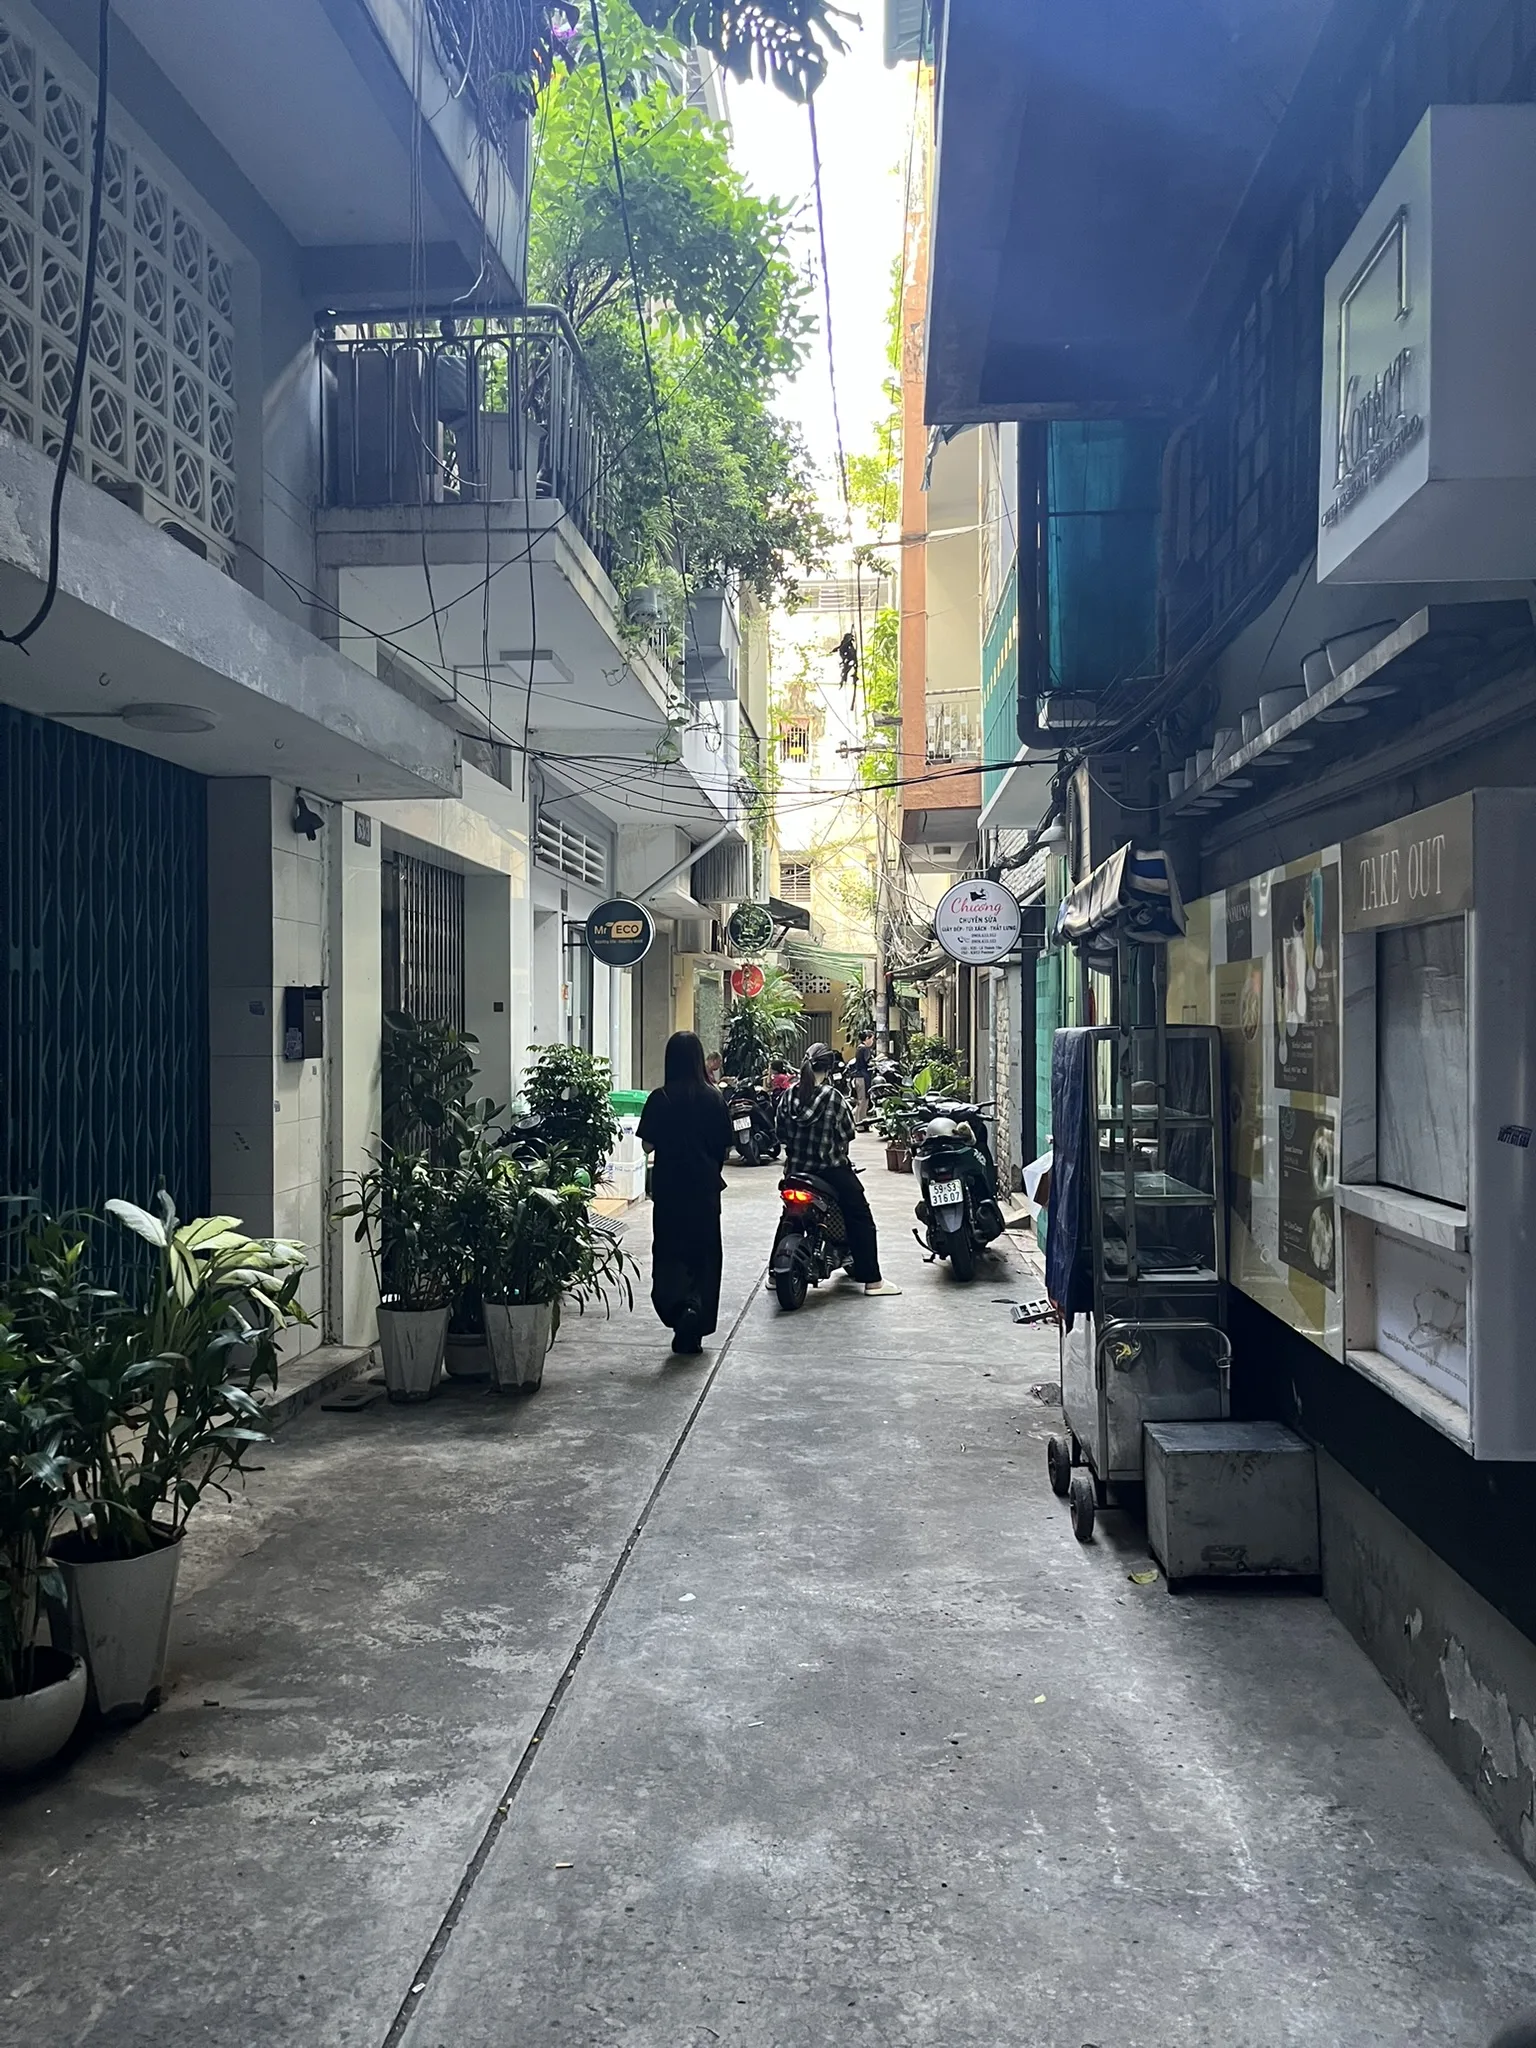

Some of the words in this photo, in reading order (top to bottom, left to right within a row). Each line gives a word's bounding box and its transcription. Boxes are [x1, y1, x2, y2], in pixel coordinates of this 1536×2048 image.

[1360, 849, 1400, 911] TAKE
[1408, 834, 1446, 900] OUT
[594, 925, 607, 934] Mr
[616, 925, 639, 934] ECO
